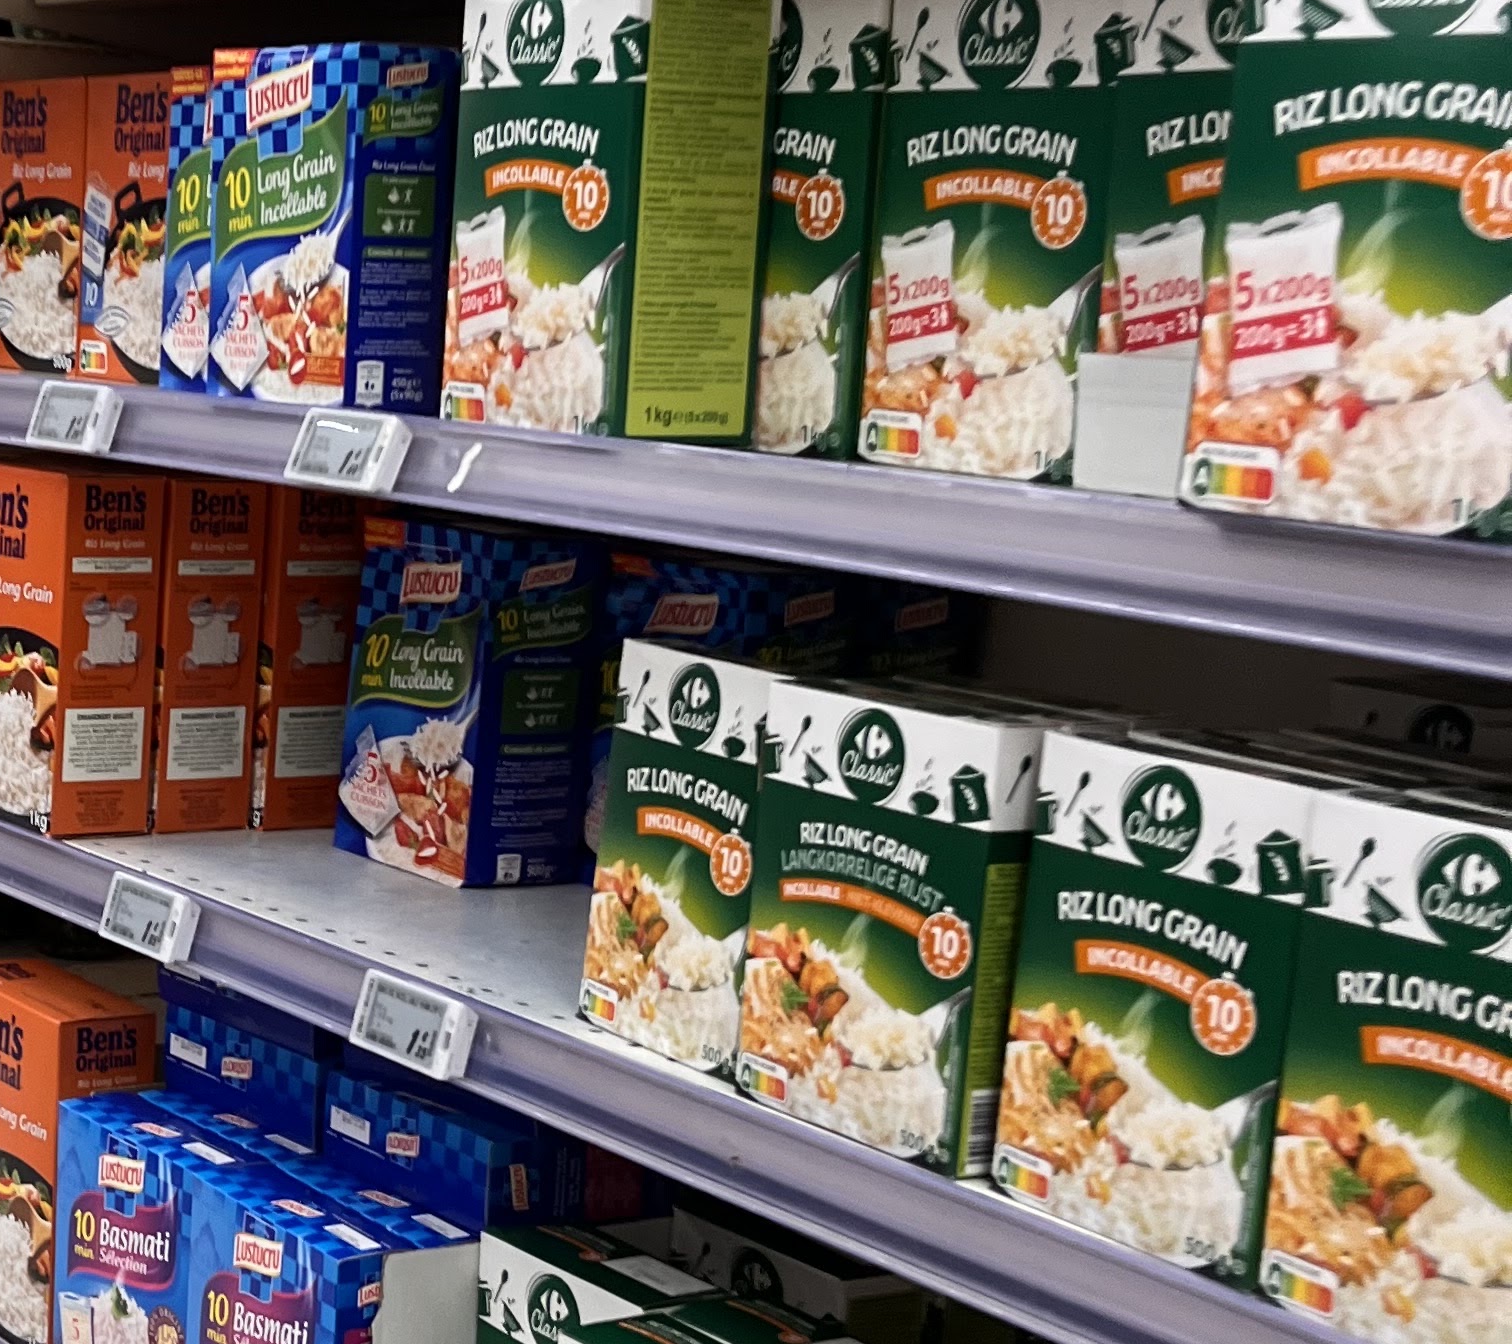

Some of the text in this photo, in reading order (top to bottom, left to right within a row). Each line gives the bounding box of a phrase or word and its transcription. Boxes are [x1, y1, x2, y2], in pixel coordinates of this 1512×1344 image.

[510, 34, 560, 65] Classic
[964, 33, 1035, 67] Classic
[3, 87, 47, 128] Ben's
[115, 83, 168, 124] Ben's
[248, 70, 309, 122] Lustucru
[1275, 81, 1424, 136] RIZ LONG
[115, 126, 166, 157] Original
[474, 117, 600, 158] RIZ LONG GRAIN
[907, 125, 1078, 167] RIZ LONG GRAIN
[1146, 121, 1186, 155] RIZ
[225, 167, 250, 210] 10
[257, 150, 335, 200] Long Grain
[492, 166, 563, 188] INCOLLABLE
[176, 173, 199, 213] 10
[260, 185, 327, 227] Incollable
[574, 180, 598, 207] 10
[805, 191, 834, 218] 10
[1044, 196, 1073, 224] 10
[229, 212, 252, 233] min
[86, 486, 146, 512] Ben's
[192, 489, 249, 516] Ben's
[84, 515, 144, 534] Original
[22, 581, 53, 603] Grain
[366, 634, 388, 667] 10
[390, 668, 453, 691] Incollable
[627, 768, 748, 826] RIZ LONG GRAIN
[645, 812, 714, 848] INCOLLABLE
[722, 848, 739, 877] 10
[800, 822, 930, 876] RIZ LONG GRAIN
[781, 849, 945, 912] LANGKORRELIGE RIJST
[932, 927, 958, 961] 10
[1057, 890, 1248, 969] RIZ LONG GRAIN
[1338, 970, 1474, 1020] RIZ LONG
[1207, 997, 1240, 1034] 10
[76, 1023, 137, 1054] Ben's
[75, 1054, 137, 1073] Original
[19, 1113, 47, 1141] Grain
[101, 1160, 142, 1187] Lustucru
[74, 1209, 95, 1241] 10
[99, 1218, 170, 1262] Basmati
[99, 1248, 147, 1276] Sélection
[236, 1235, 280, 1270] Lustucru
[207, 1290, 229, 1326] 10
